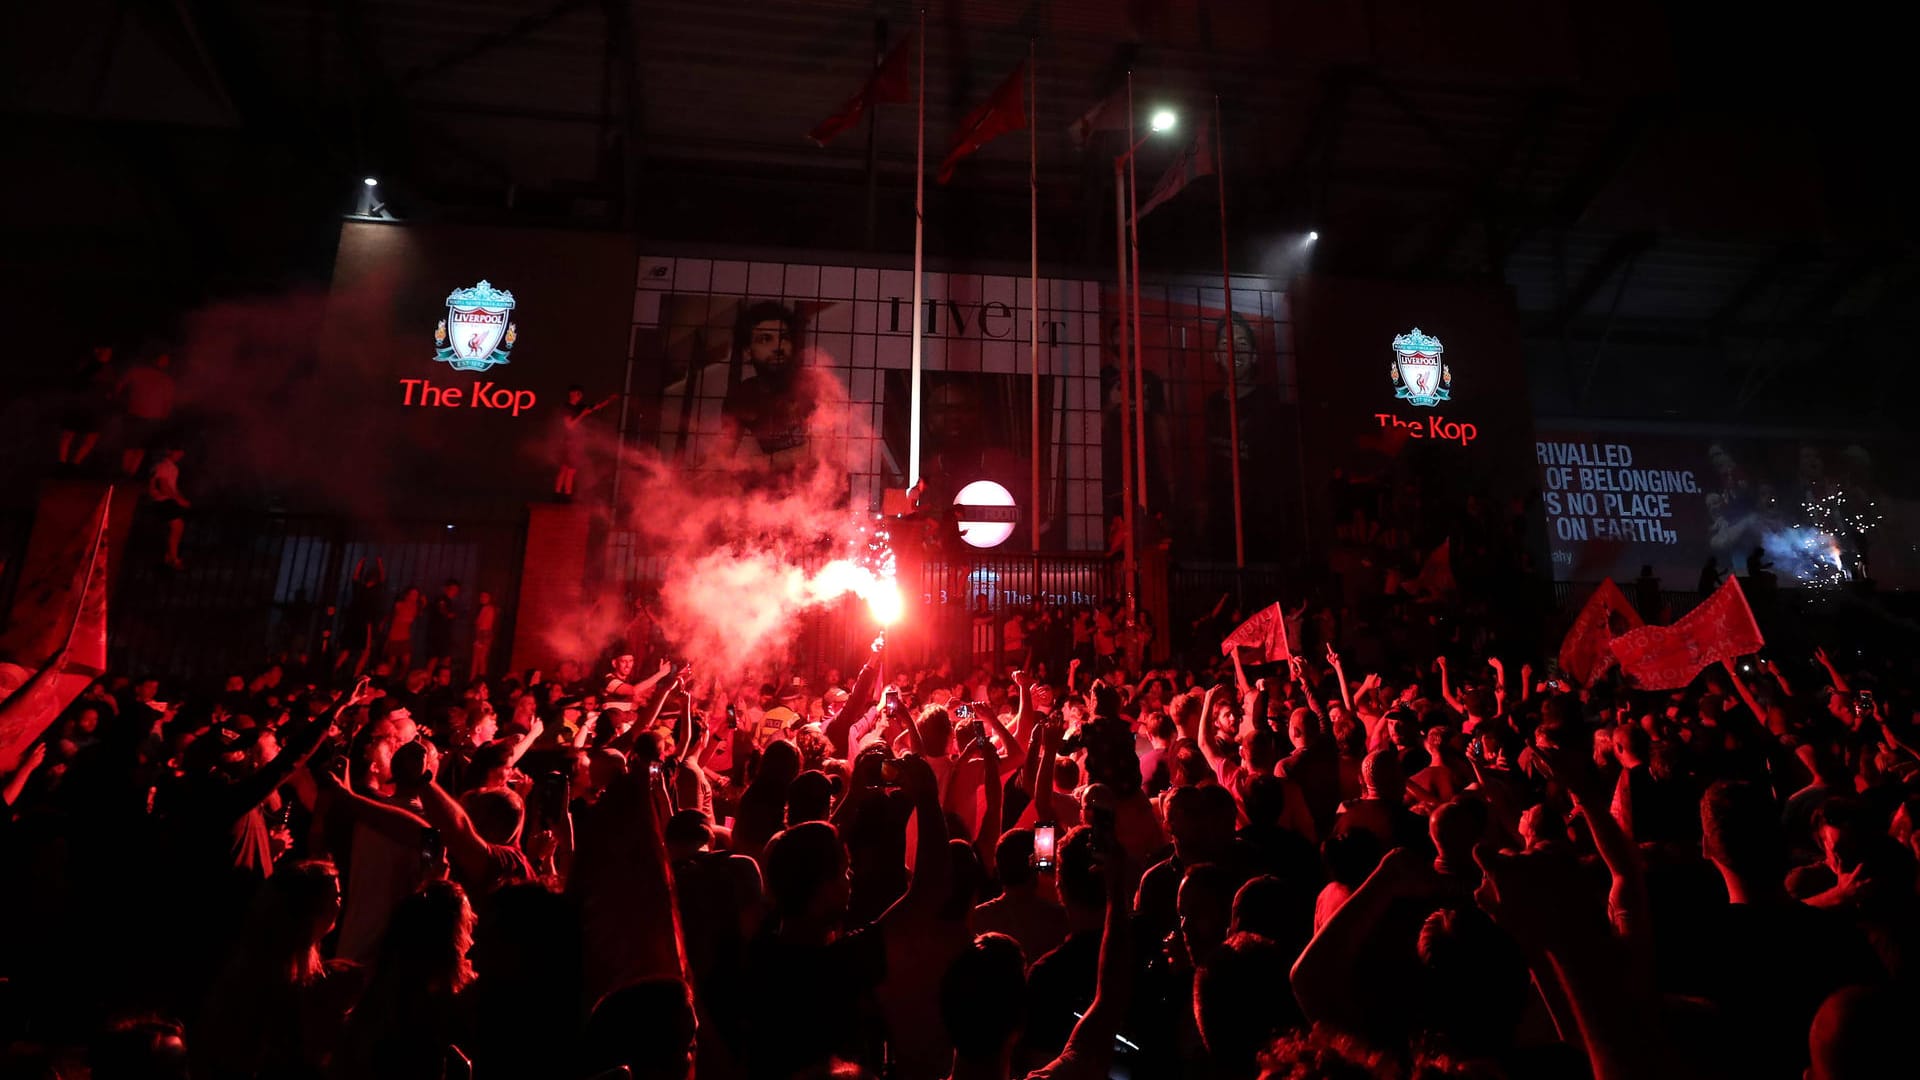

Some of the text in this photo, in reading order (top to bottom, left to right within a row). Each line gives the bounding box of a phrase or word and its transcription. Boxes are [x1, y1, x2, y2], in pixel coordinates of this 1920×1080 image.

[454, 313, 503, 325] LIVERPOOL
[1401, 356, 1438, 366] LIVERPOOL
[399, 378, 537, 417] The Kop
[1428, 415, 1478, 447] Kop
[1546, 466, 1702, 494] OF BELONGING.
[1567, 492, 1598, 516] NO
[1603, 493, 1673, 518] PLACE
[1556, 517, 1589, 541] ON
[1003, 590, 1032, 605] The
